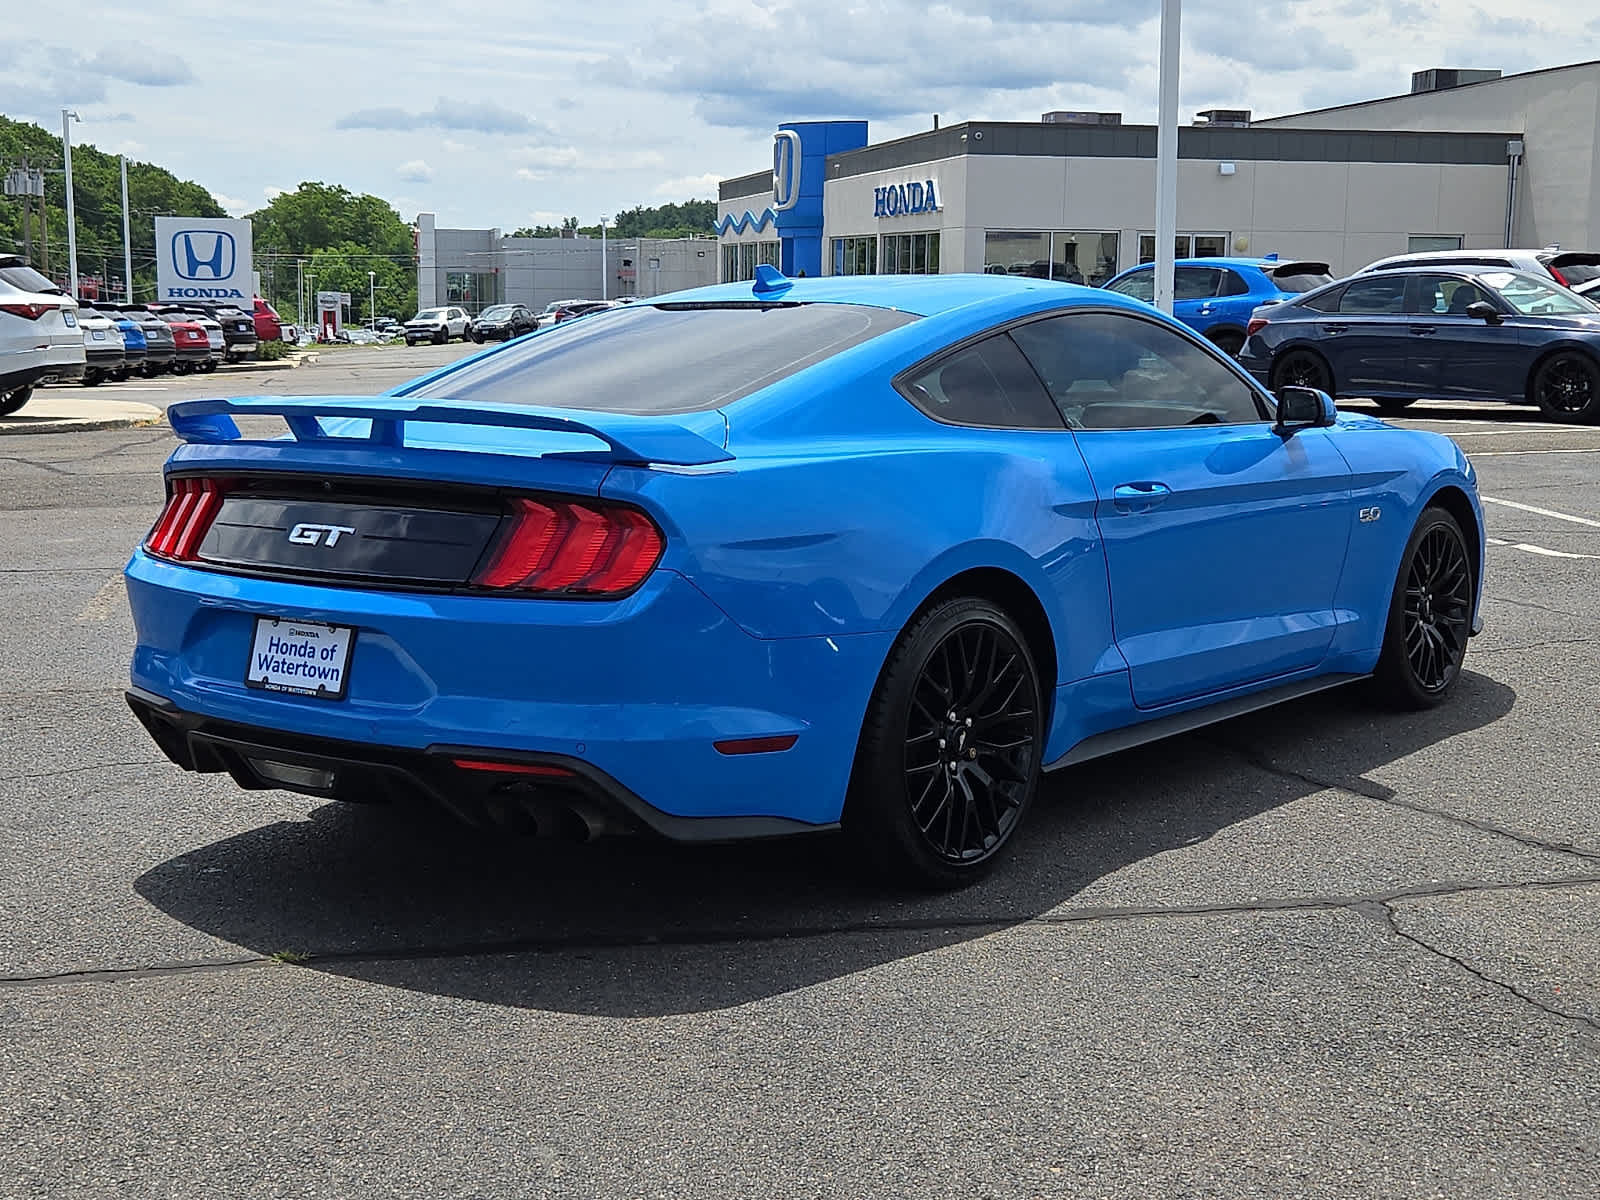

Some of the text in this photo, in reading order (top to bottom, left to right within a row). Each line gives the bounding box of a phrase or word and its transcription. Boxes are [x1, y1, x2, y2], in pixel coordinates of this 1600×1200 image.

[874, 179, 940, 217] HONDA
[168, 287, 245, 298] HONDA
[289, 523, 356, 548] GT
[268, 635, 338, 661] Honda of
[258, 653, 340, 682] Watertown
